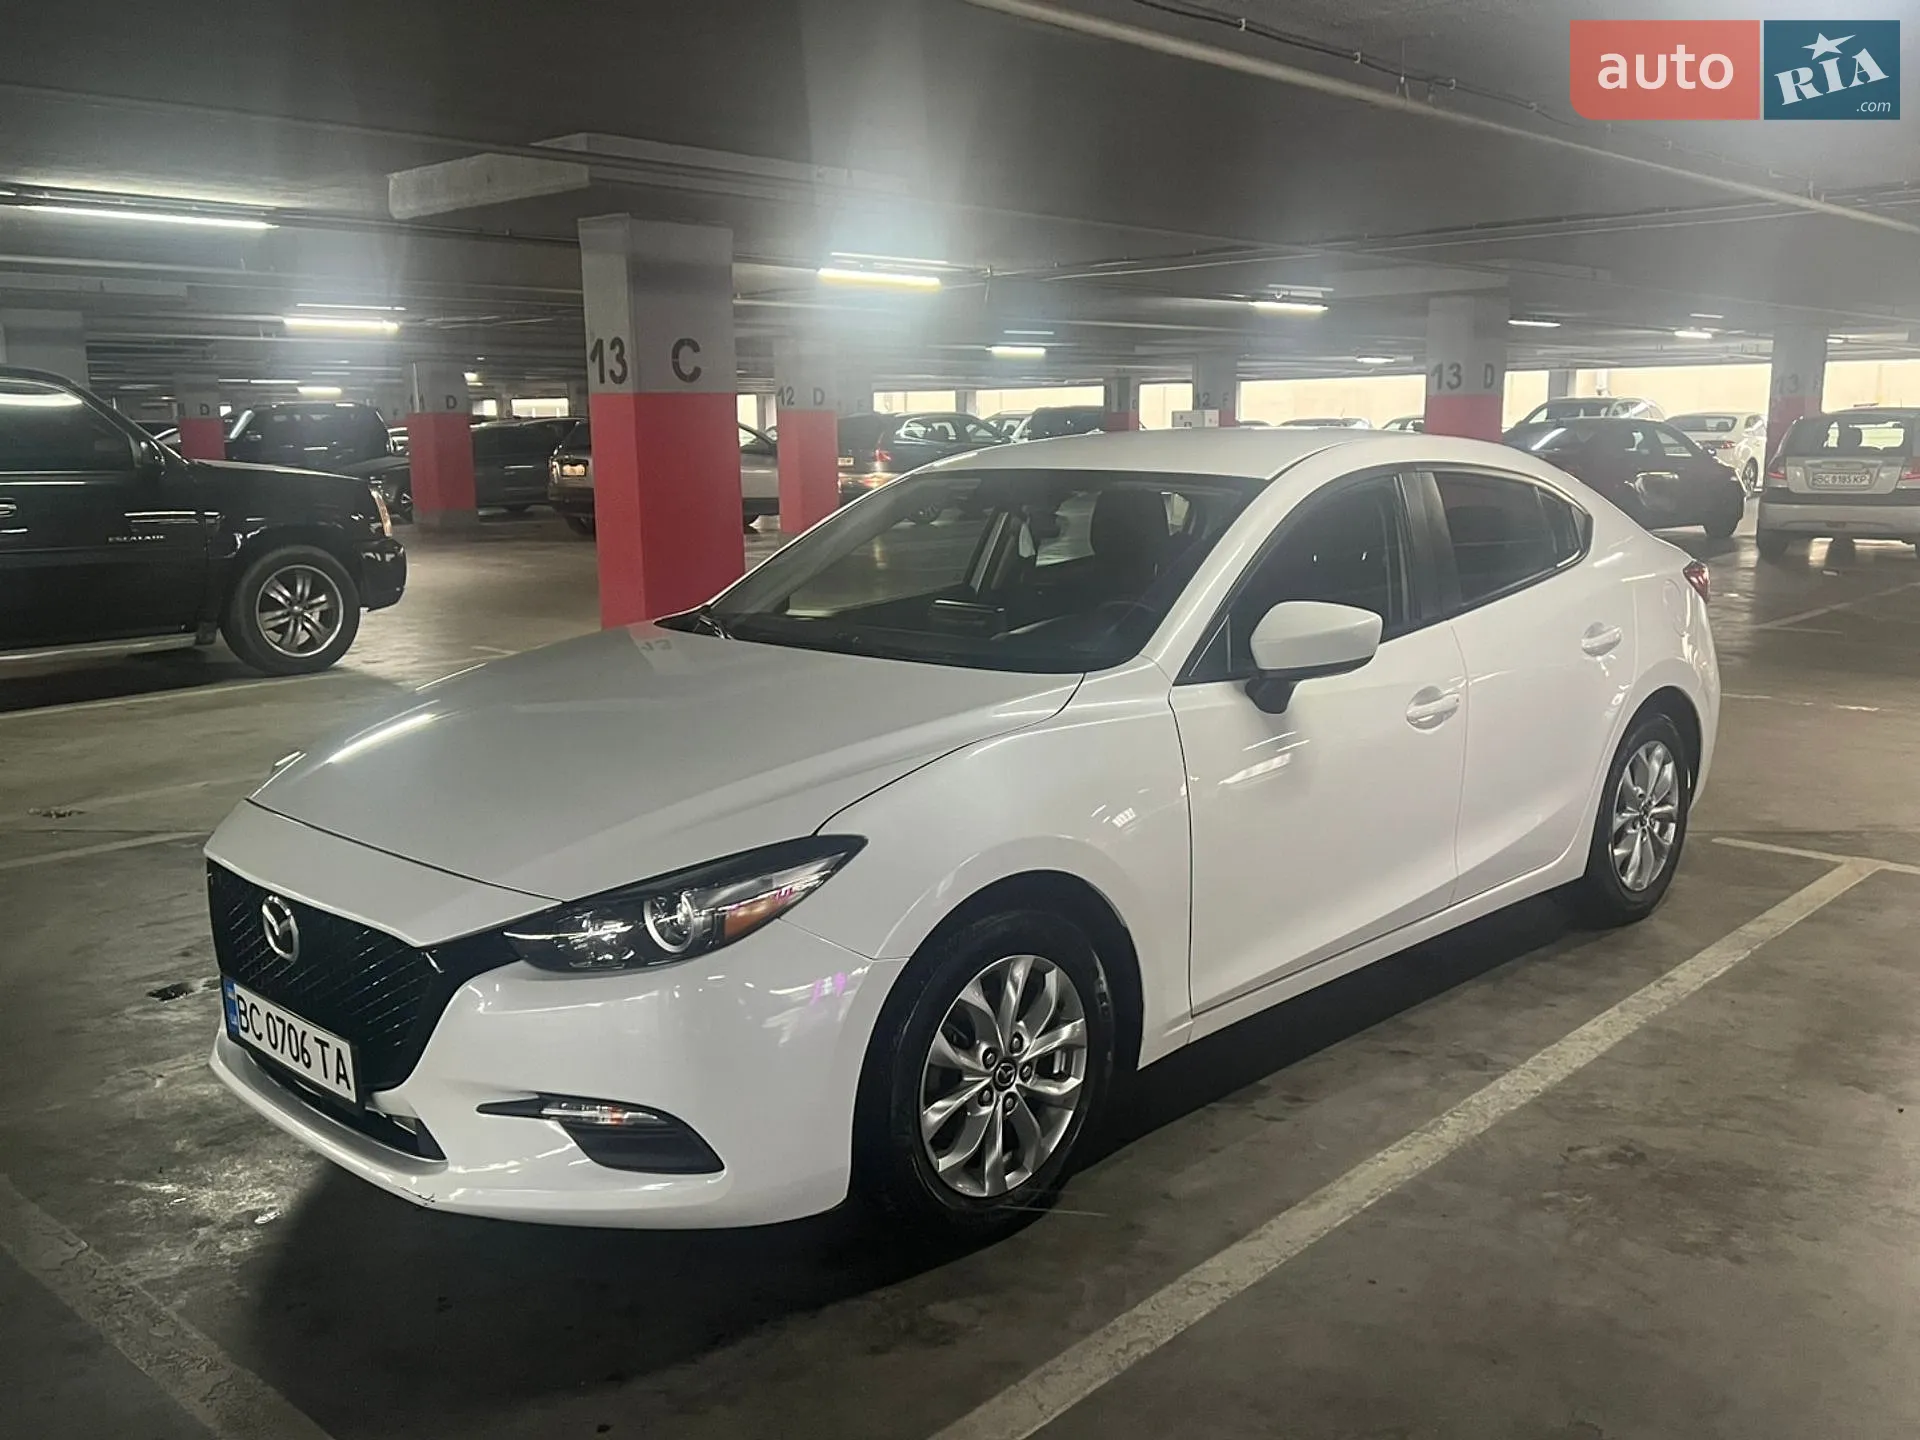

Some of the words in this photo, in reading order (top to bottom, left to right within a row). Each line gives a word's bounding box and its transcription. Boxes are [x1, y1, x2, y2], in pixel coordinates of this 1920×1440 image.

[590, 337, 628, 385] 13
[672, 338, 702, 383] C
[1431, 362, 1462, 391] 13
[1484, 363, 1495, 389] D
[446, 395, 458, 409] D
[777, 386, 795, 406] 12
[813, 387, 825, 406] D
[200, 403, 210, 416] D
[237, 994, 263, 1041] BC
[265, 1011, 311, 1069] 0706
[313, 1036, 351, 1091] TA
